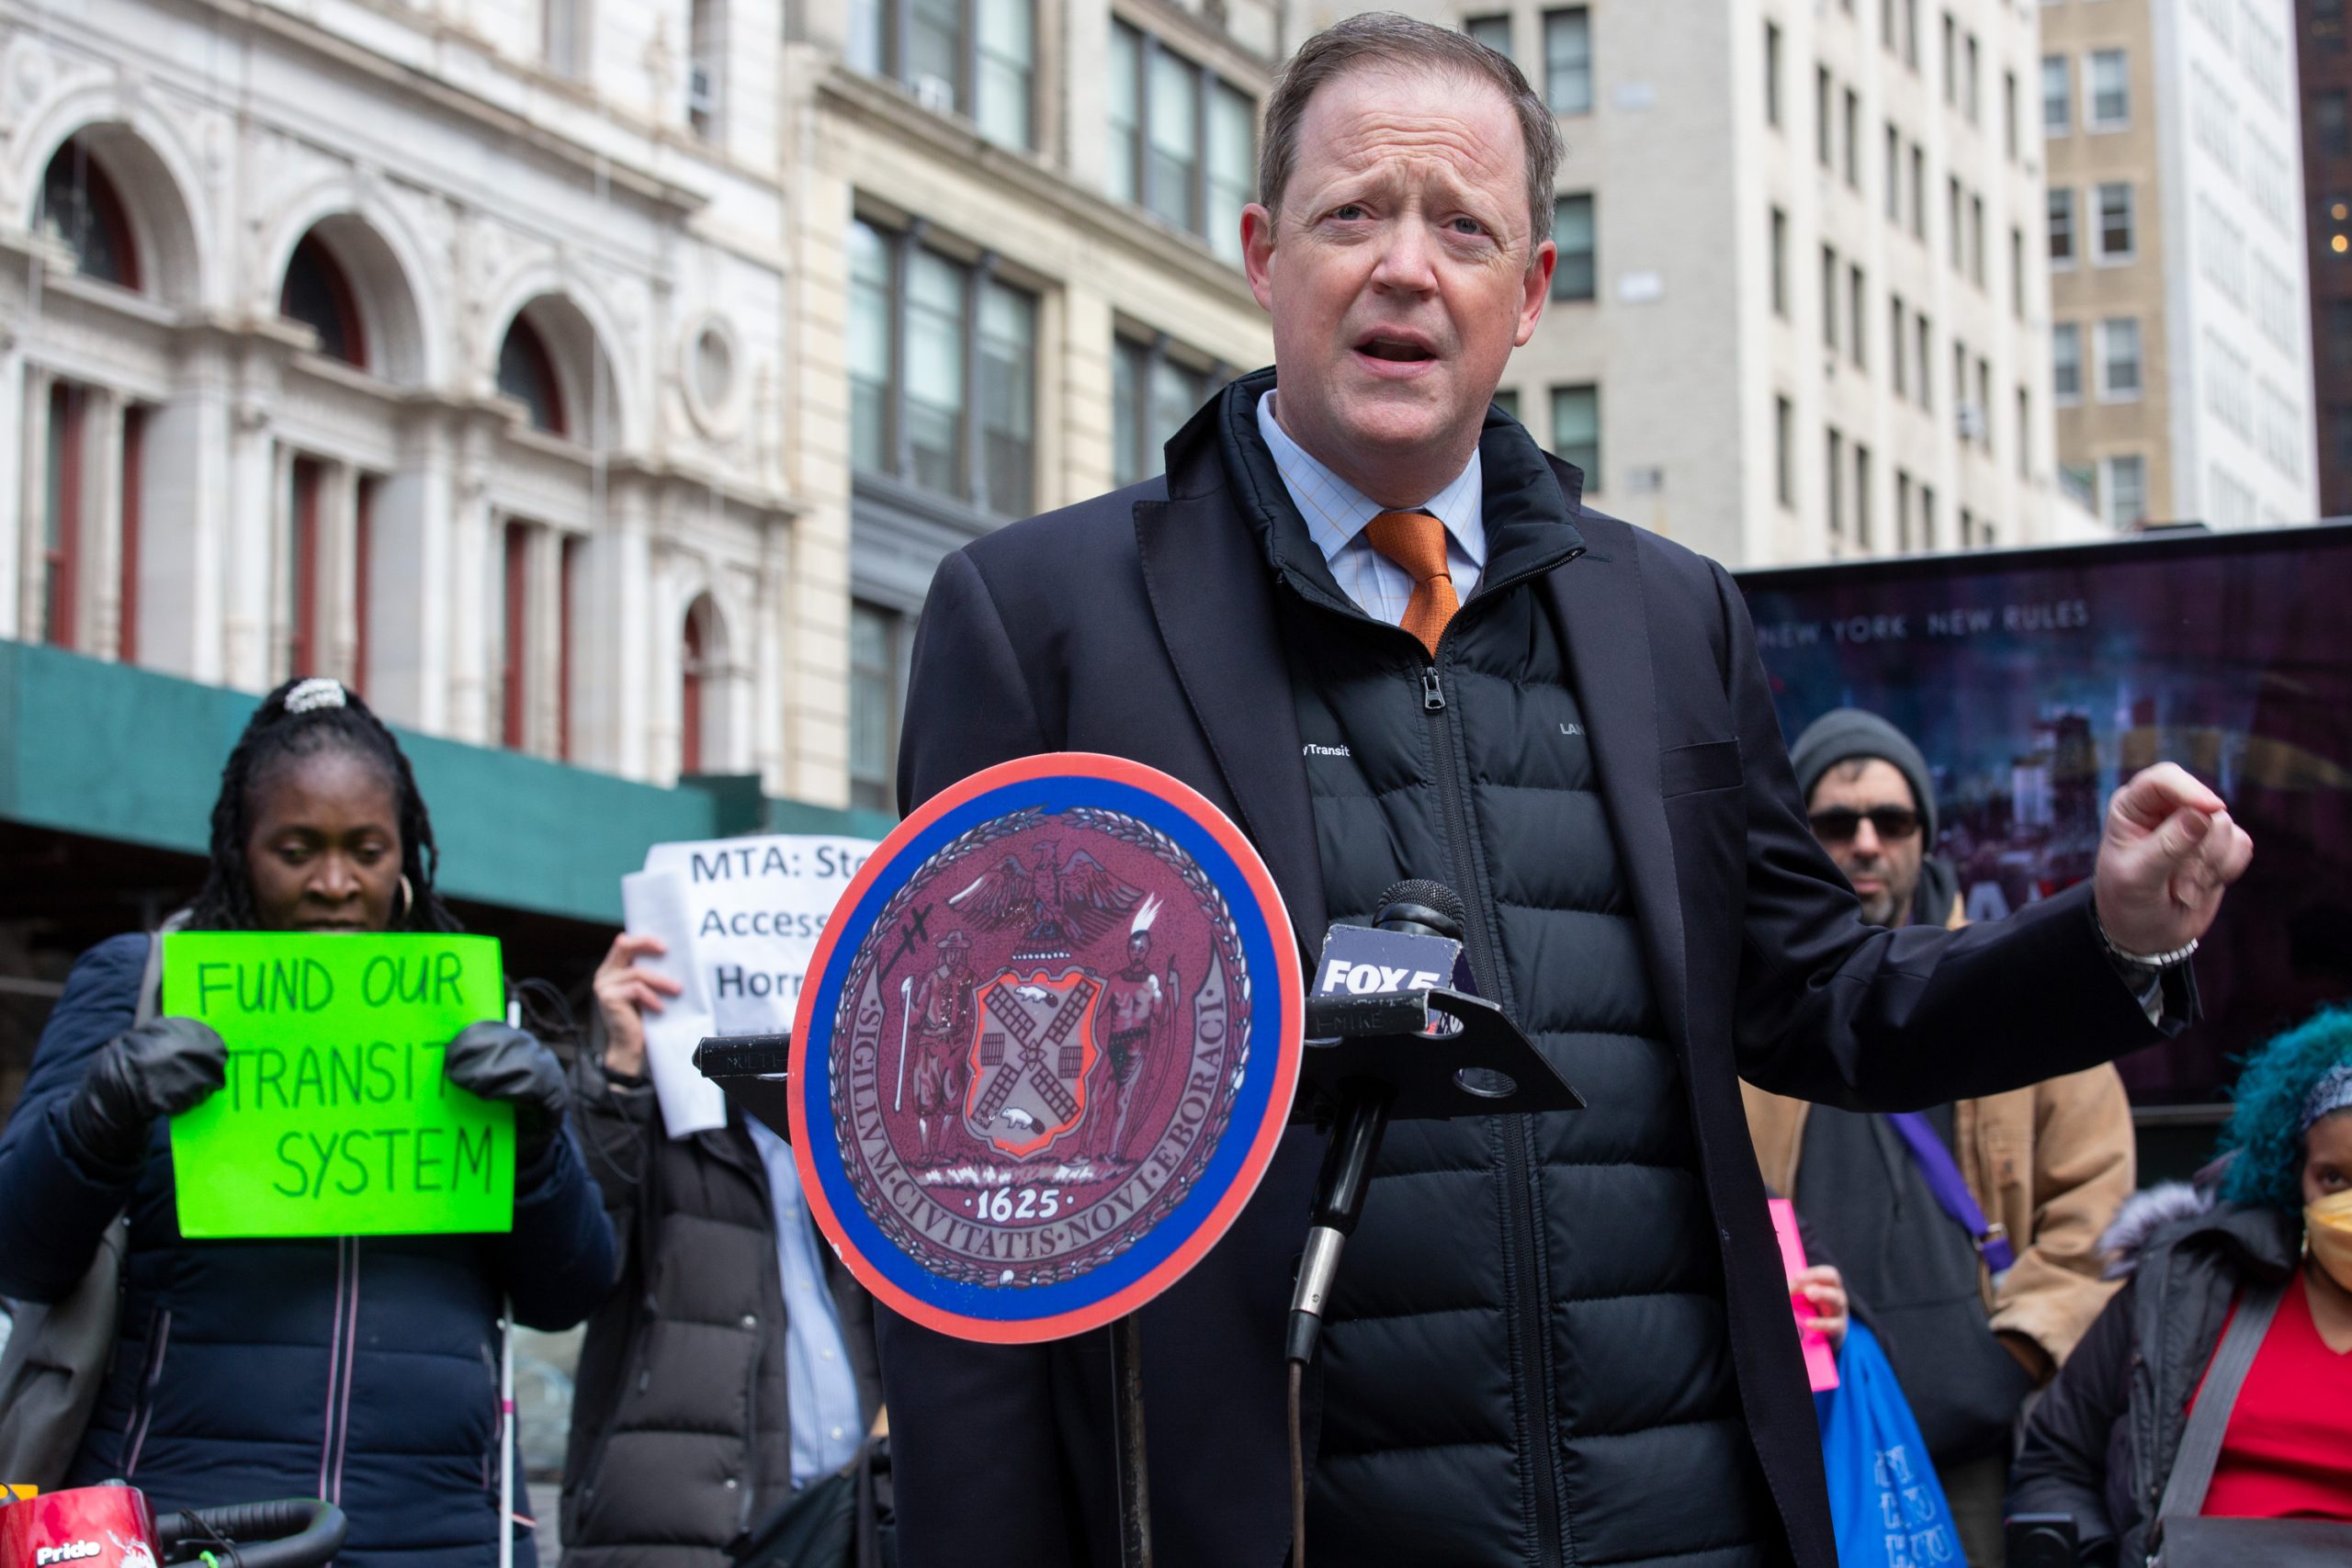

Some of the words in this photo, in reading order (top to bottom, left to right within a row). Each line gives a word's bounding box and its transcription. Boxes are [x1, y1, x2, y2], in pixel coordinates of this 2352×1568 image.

[1831, 614, 1909, 644] YORK
[1927, 608, 1994, 637] NEW
[2002, 599, 2089, 631] RULES
[692, 845, 801, 884] MTA:
[197, 957, 334, 1016] FUND
[361, 951, 463, 1008] OUR
[1322, 959, 1409, 995] FOX
[227, 1041, 450, 1112] TRANSIT
[852, 1008, 897, 1186] SIGILLVM
[889, 1184, 1055, 1258] CIVITATIS
[1066, 1175, 1161, 1248] NOVI
[1151, 998, 1225, 1177] EBORACI
[272, 1124, 493, 1200] SYSTEM
[978, 1187, 1060, 1223] 1625
[37, 1540, 101, 1565] Pride
